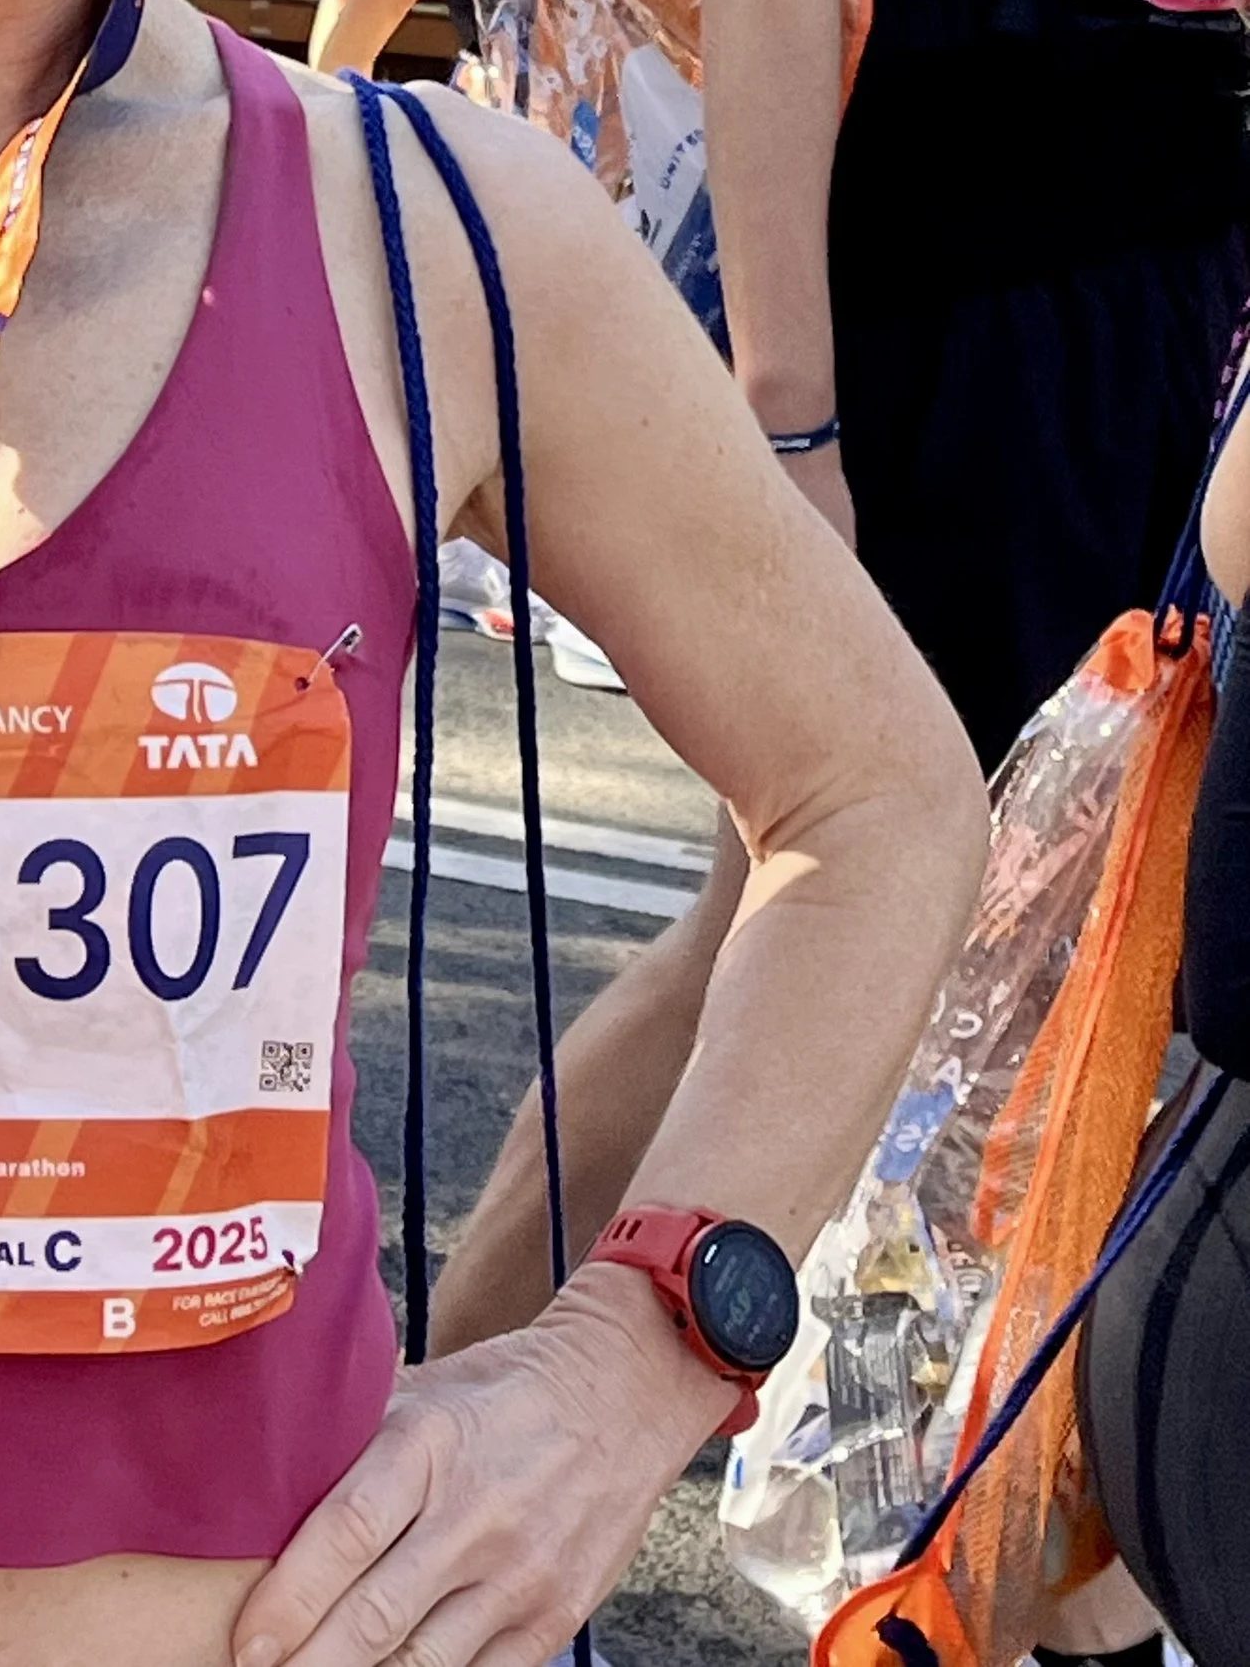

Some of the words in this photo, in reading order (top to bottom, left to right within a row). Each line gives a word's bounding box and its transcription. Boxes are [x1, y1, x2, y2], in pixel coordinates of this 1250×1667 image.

[137, 733, 259, 770] TATA
[44, 1229, 83, 1273] C
[152, 1215, 269, 1273] 2025
[102, 1297, 137, 1339] B
[172, 1293, 201, 1311] FOR
